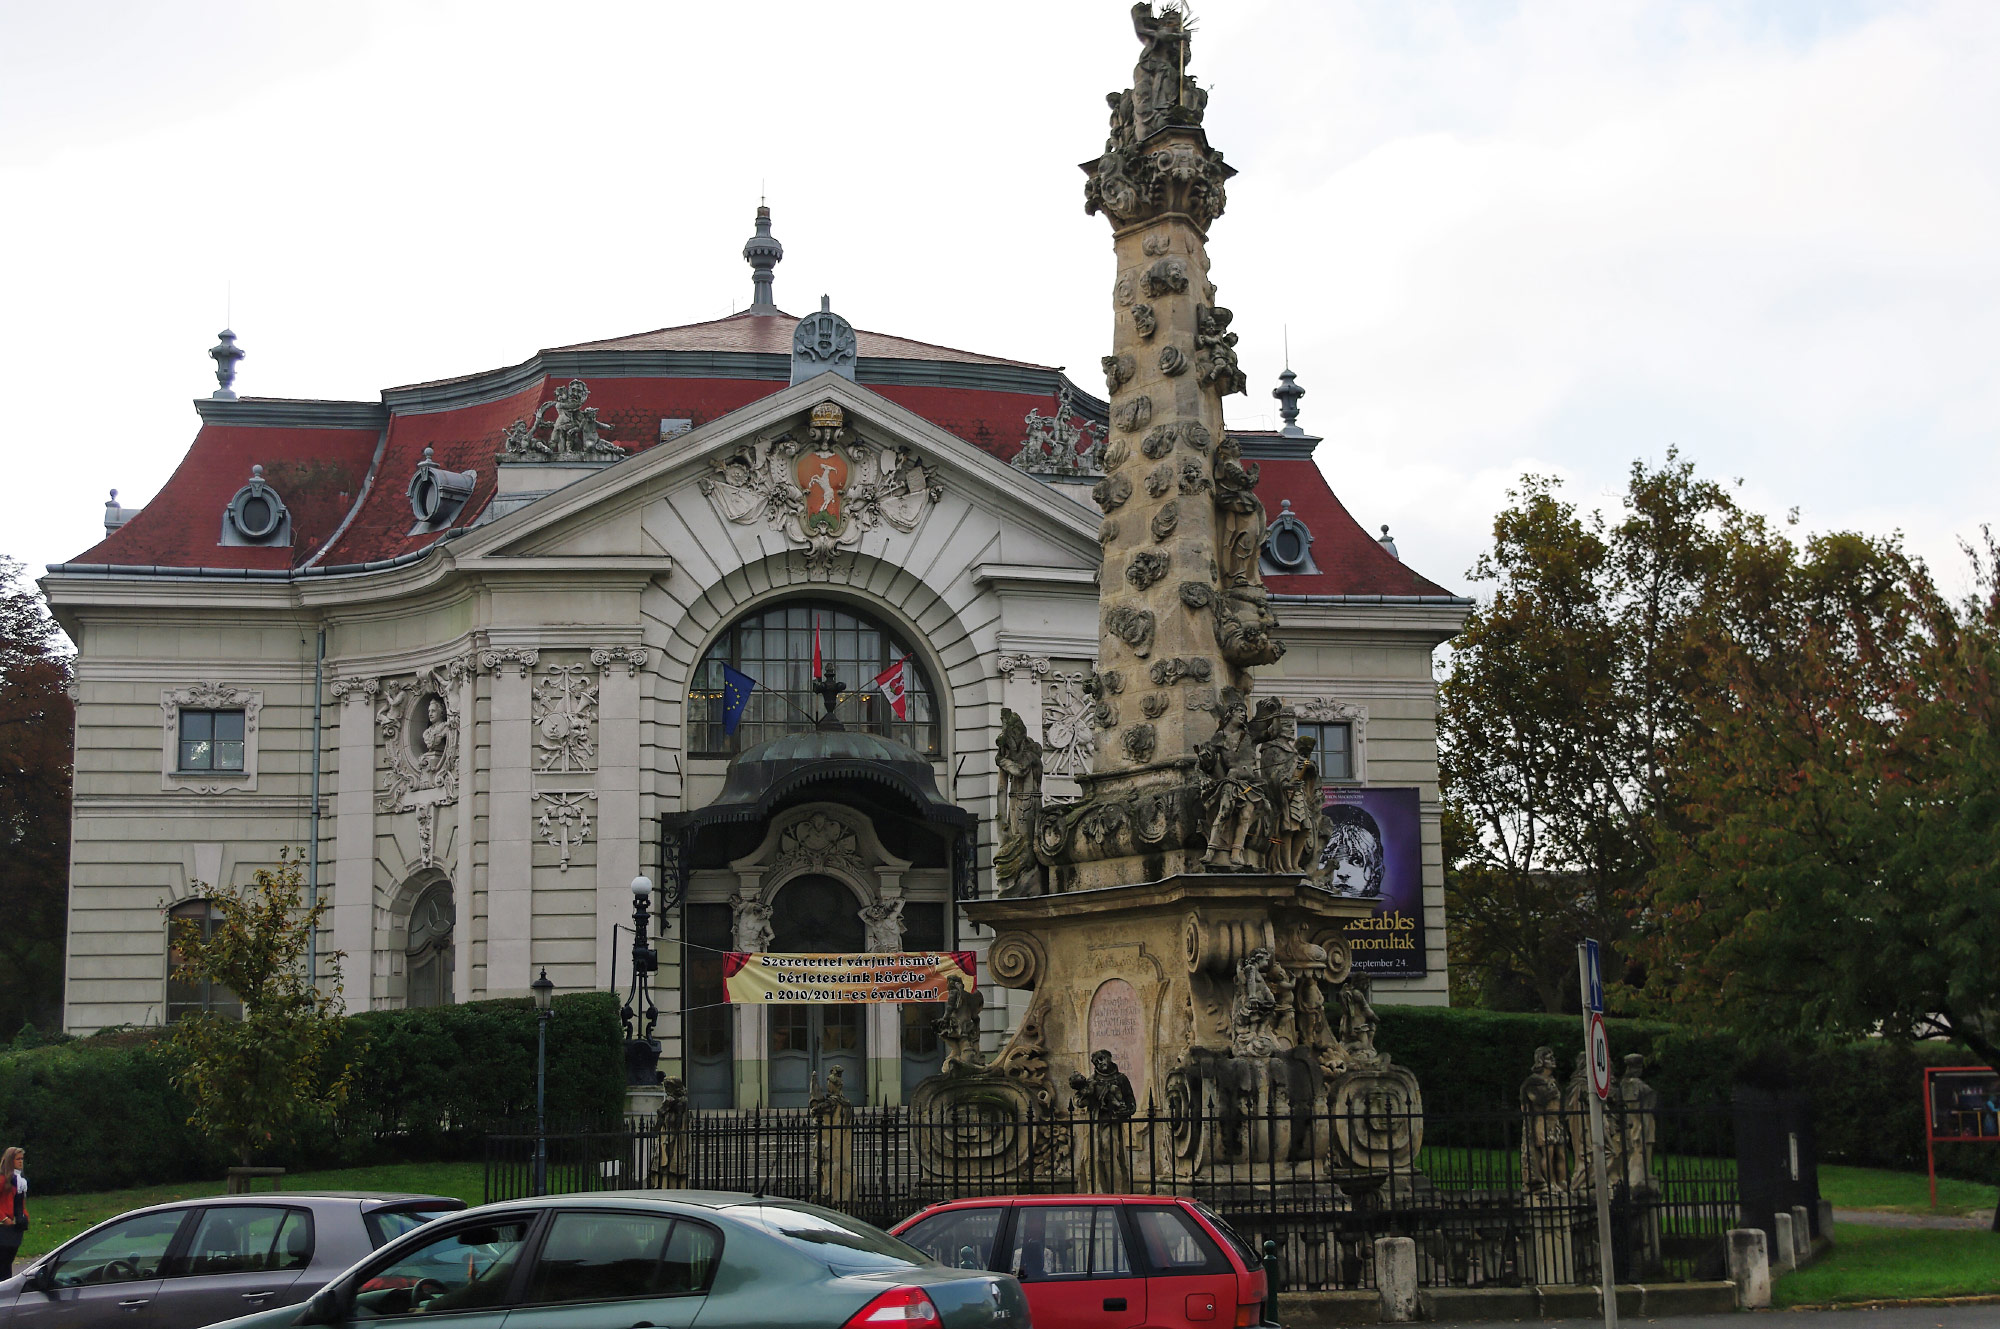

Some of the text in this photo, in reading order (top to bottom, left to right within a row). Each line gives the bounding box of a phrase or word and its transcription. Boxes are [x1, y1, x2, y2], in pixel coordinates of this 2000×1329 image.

[761, 955, 940, 968] Szeretettel várjuk ismét
[1395, 958, 1409, 967] 24.
[777, 971, 926, 983] bérleteseink körébe
[764, 987, 939, 1001] a 2010/2011-es évadban!
[1597, 1038, 1606, 1072] 40
